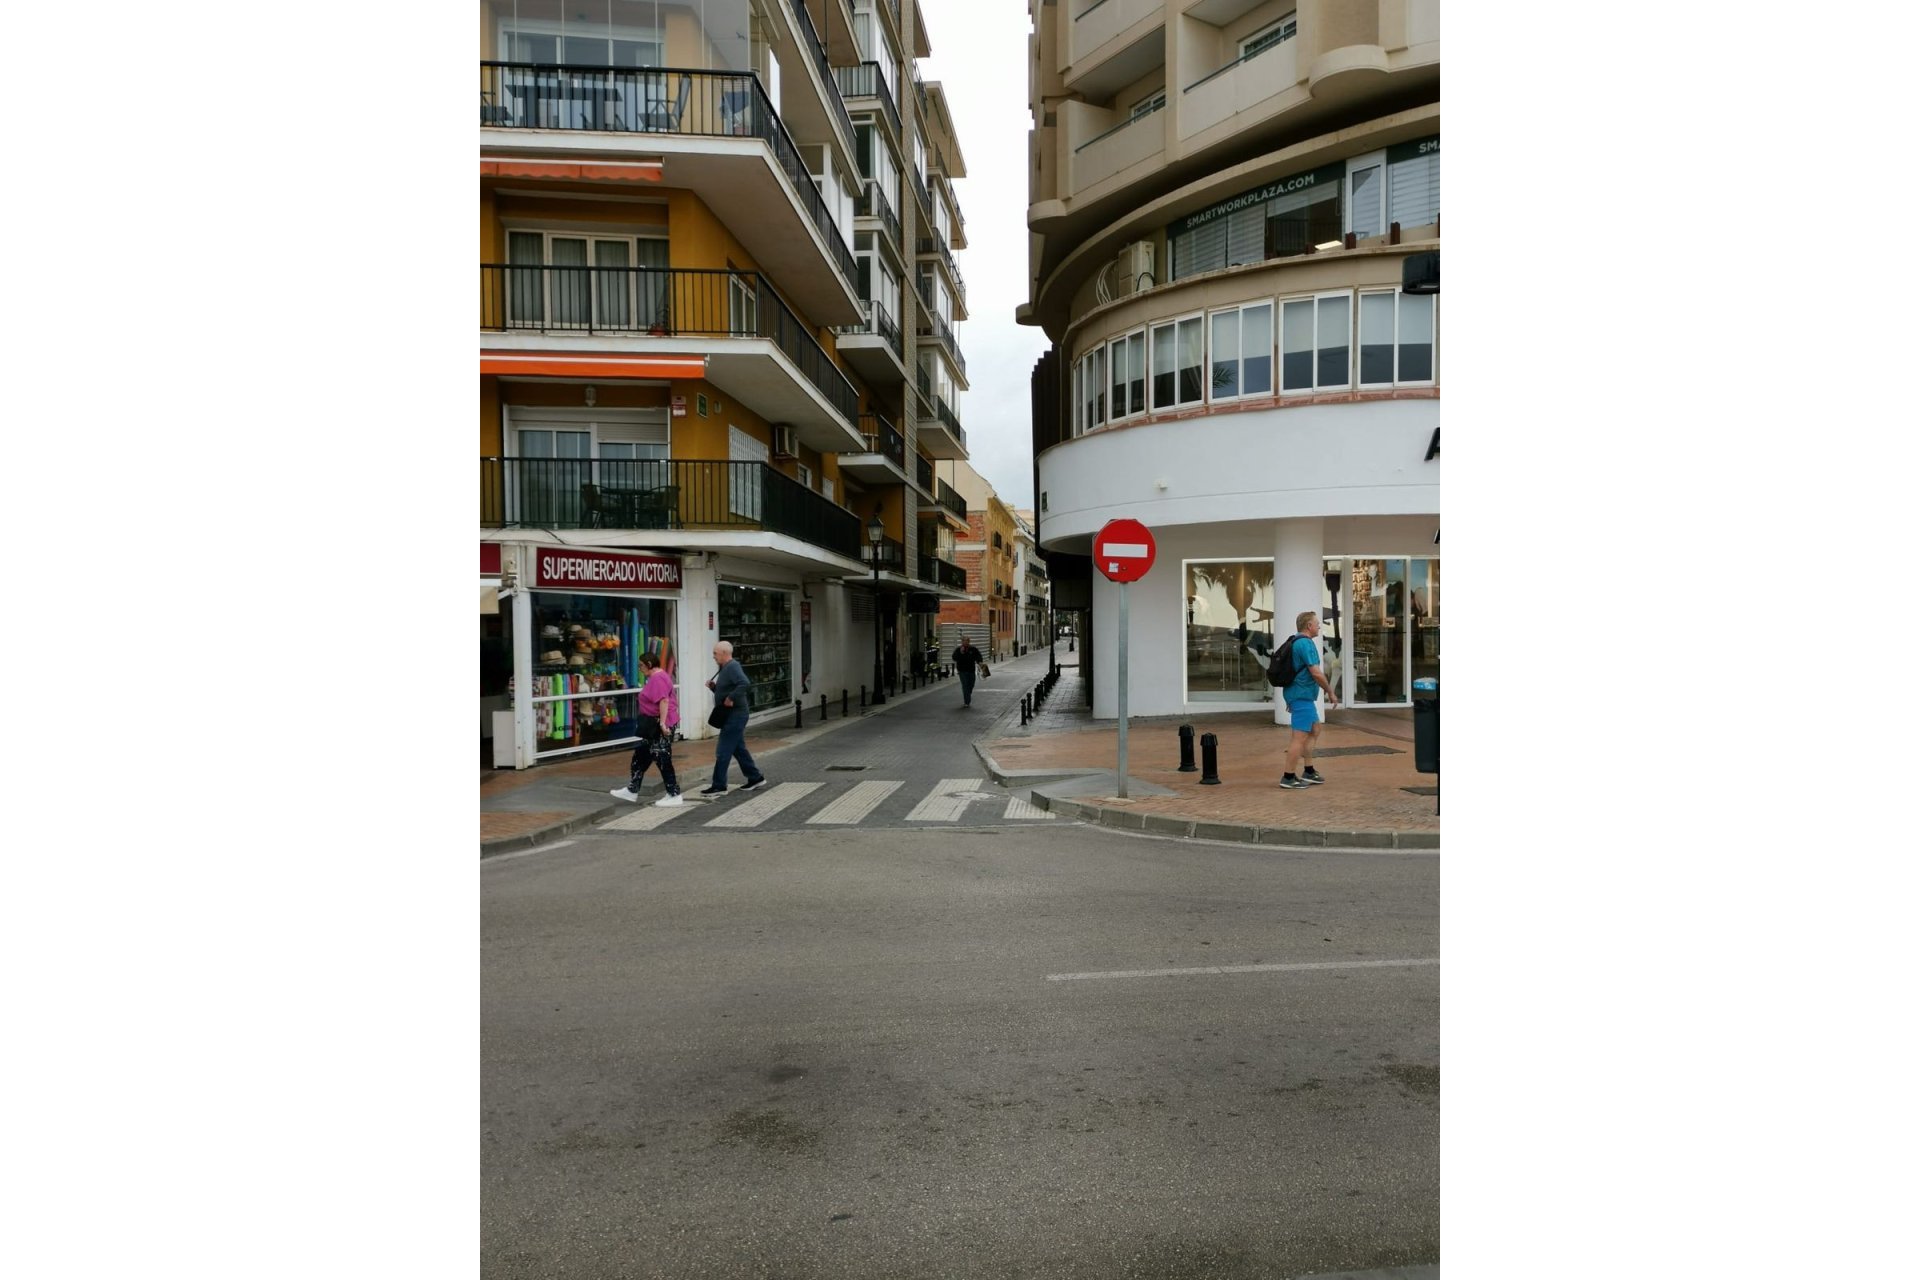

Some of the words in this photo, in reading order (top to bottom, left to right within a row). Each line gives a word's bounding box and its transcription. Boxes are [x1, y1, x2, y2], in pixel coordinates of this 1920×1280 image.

[1186, 173, 1315, 228] SMARTWORKPLAZA.COM
[543, 556, 635, 581] SUPERMERCADO
[637, 562, 679, 583] VICTORIA
